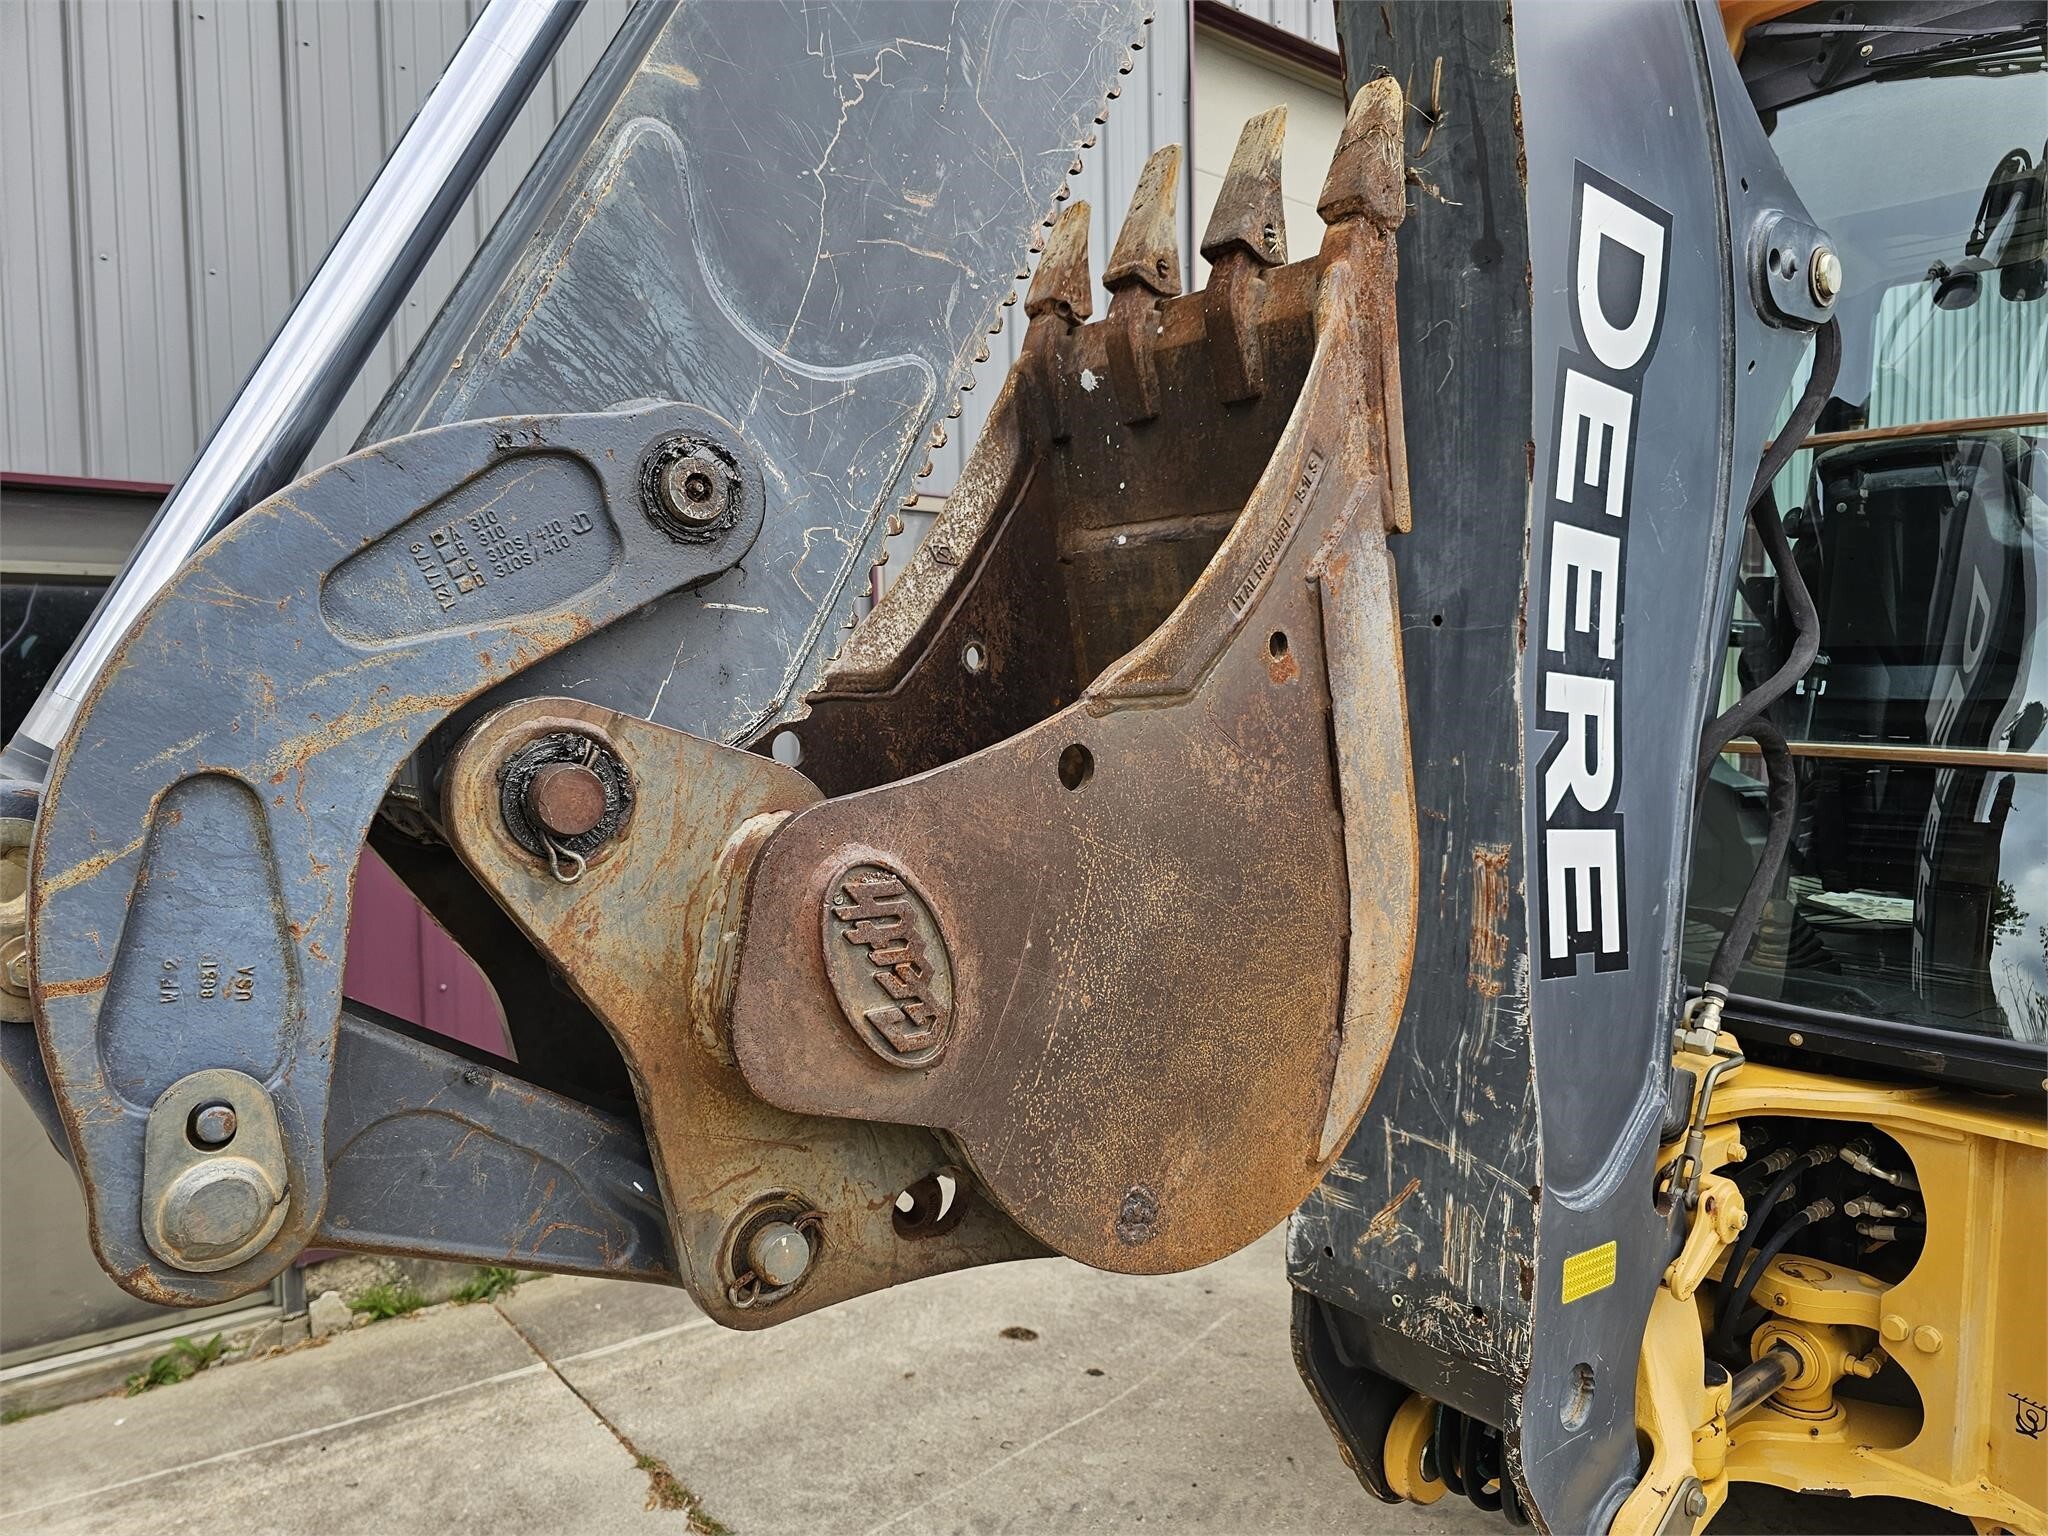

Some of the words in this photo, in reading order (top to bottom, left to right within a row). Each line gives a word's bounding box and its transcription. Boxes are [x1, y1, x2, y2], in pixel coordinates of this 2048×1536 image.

[450, 525, 463, 541] A
[469, 510, 498, 532] 310
[455, 541, 469, 556] B
[478, 525, 507, 546] 310
[465, 556, 478, 572] C
[472, 571, 486, 588] D
[1231, 516, 1292, 612] ITALRICAMBI
[1543, 180, 1667, 961] DEERE
[234, 963, 257, 1001] USA
